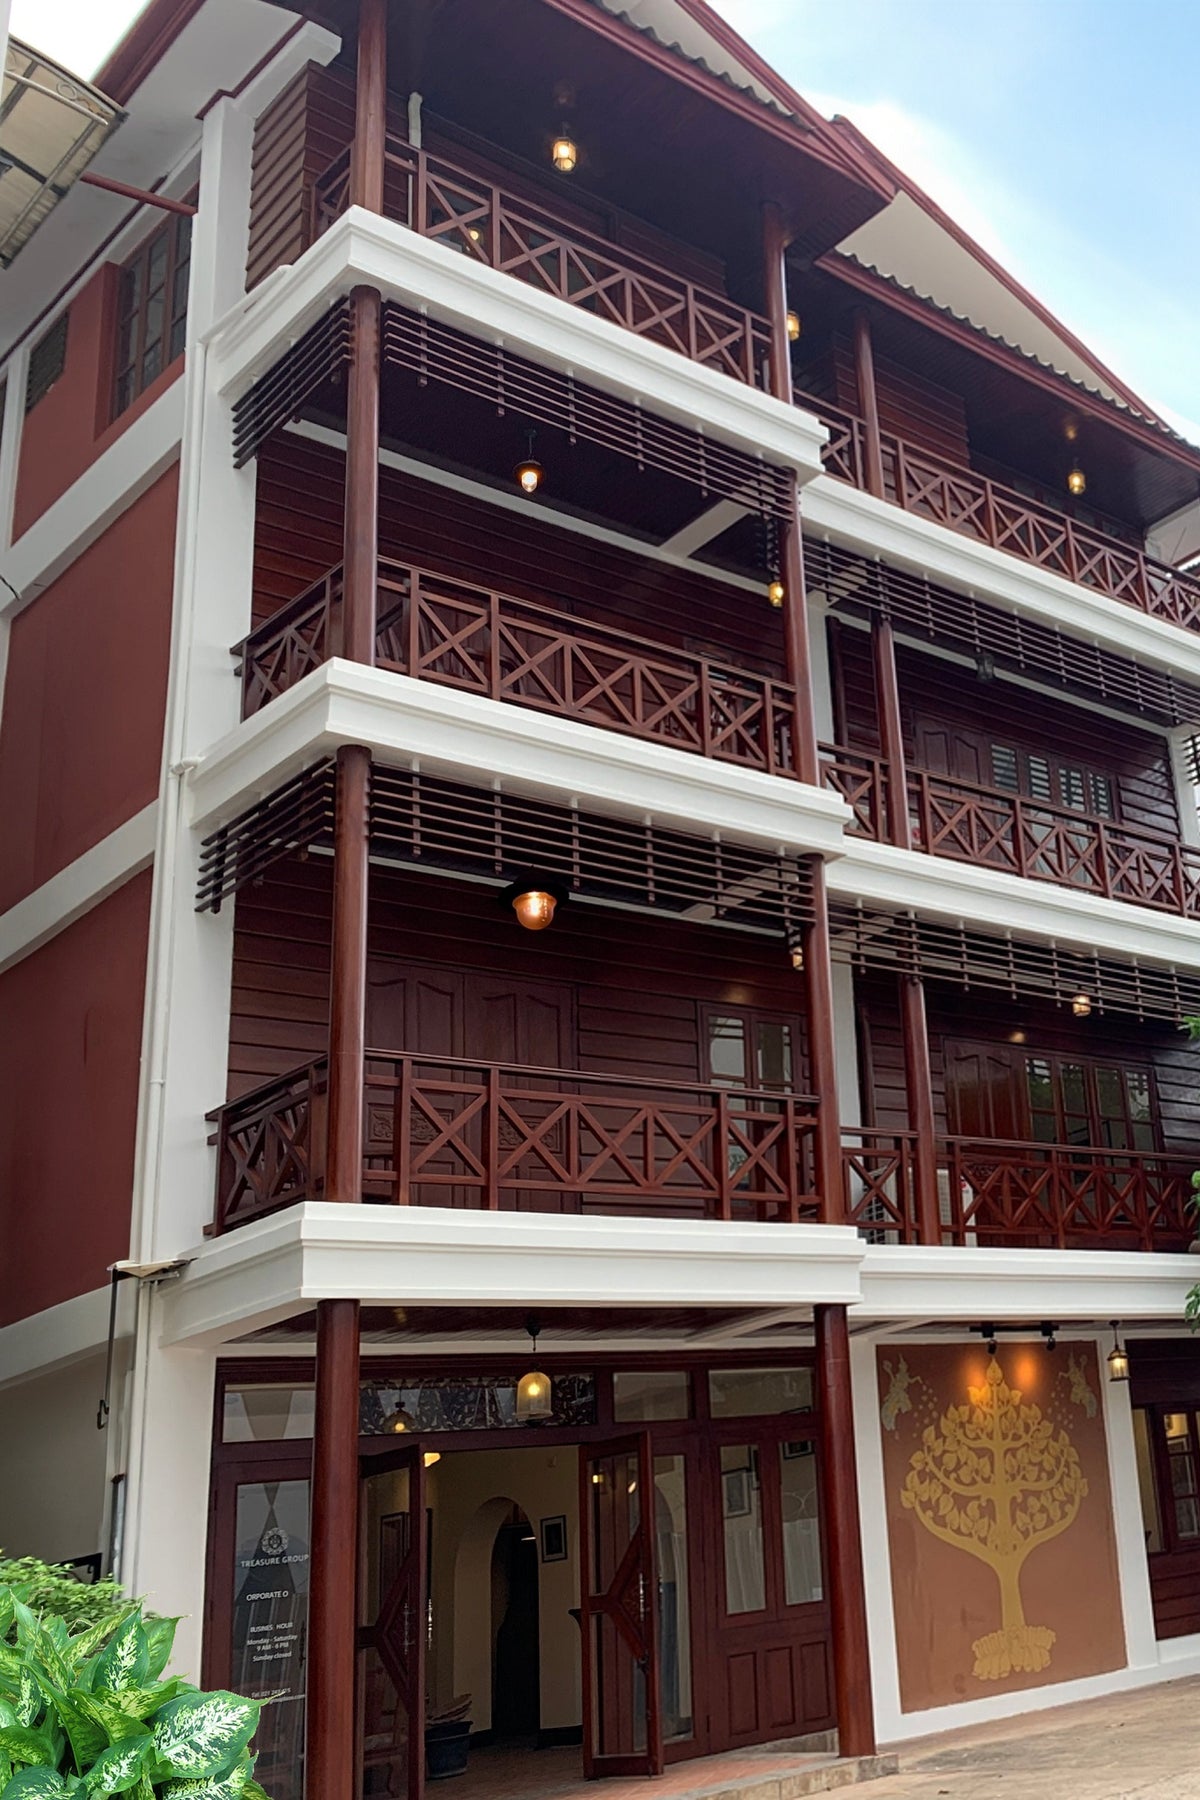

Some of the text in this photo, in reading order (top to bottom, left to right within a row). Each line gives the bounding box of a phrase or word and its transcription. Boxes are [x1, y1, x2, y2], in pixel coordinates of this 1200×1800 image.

[241, 1554, 309, 1567] TREASURE GROUP
[246, 1591, 281, 1601] ORPORATE
[247, 1638, 270, 1646] Monday
[273, 1634, 298, 1642] Saturday
[253, 1650, 292, 1662] Sunday closed
